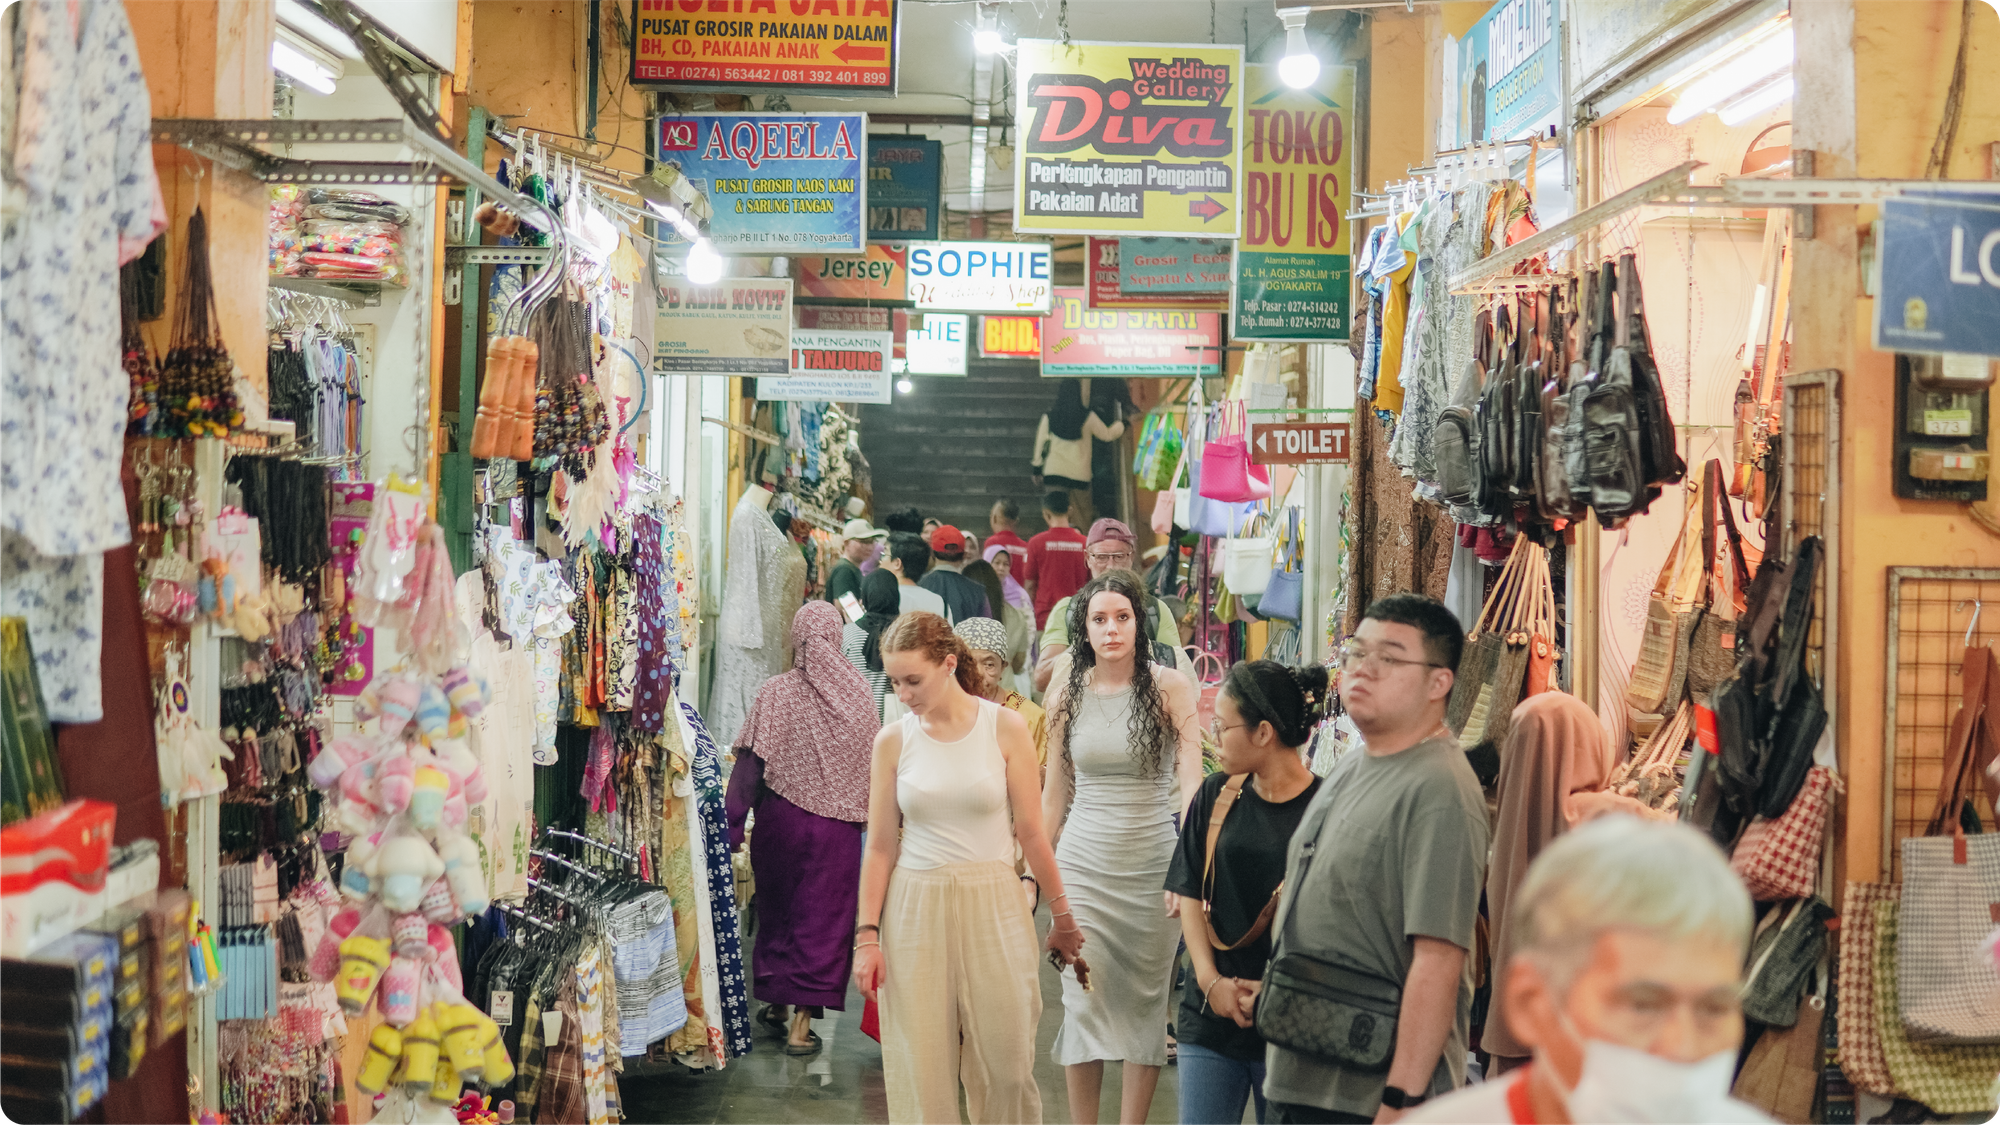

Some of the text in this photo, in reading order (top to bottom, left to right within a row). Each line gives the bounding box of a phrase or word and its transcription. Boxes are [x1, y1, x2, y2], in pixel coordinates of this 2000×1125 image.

[642, 19, 888, 41] PUSAT GROSIR PAKAIAN DALAM
[641, 38, 820, 59] BH, CD, PAKAIAN ANAK
[640, 66, 677, 77] TELP.
[681, 67, 720, 80] (0274)
[725, 69, 771, 81] 563442
[782, 70, 804, 82] 081
[809, 70, 832, 82] 392
[836, 71, 858, 83] 401
[863, 72, 886, 84] 899
[1134, 62, 1226, 83] Wedding
[1134, 80, 1226, 102] Gallery
[1495, 54, 1544, 115] COLLECTION
[1034, 85, 1226, 146] Diva
[664, 124, 697, 148] AQ
[701, 121, 858, 170] AQEELA
[1248, 109, 1343, 166] TOKO
[715, 178, 749, 194] PUSAT
[752, 179, 793, 193] GROSIR
[796, 178, 825, 193] KAOS
[828, 178, 855, 193] KAKI
[1030, 162, 1227, 189] Perlengkapan Pengantin
[735, 198, 834, 214] & SARUNG TANGAN
[1030, 190, 1138, 213] Pakaian Adat
[1246, 171, 1339, 249] BU IS
[740, 233, 752, 242] PB
[760, 233, 770, 242] LT
[778, 233, 792, 242] No.
[809, 233, 853, 244] Yogyakarta
[911, 249, 1049, 279] SOPHIE
[1134, 255, 1179, 266] Grosir
[1264, 256, 1289, 265] Alamat
[1291, 257, 1316, 266] Rumah
[820, 257, 895, 287] Jersey
[1130, 274, 1180, 288] Sepatu
[1184, 272, 1195, 284] &
[1243, 268, 1341, 280] JL. H. AGUS SALIM 19
[1261, 281, 1323, 292] YOGYAKARTA
[685, 287, 727, 310] ADIL
[1244, 300, 1260, 314] Telp.
[1262, 301, 1282, 313] Pasar
[1287, 301, 1338, 313] 0274-514242
[1241, 315, 1257, 330] Telp.
[1259, 315, 1284, 328] Rumah
[1290, 317, 1340, 329] 0274-377428
[817, 337, 882, 348] PENGANTIN
[802, 349, 883, 371] TANJUNG
[1273, 429, 1345, 454] TOILET
